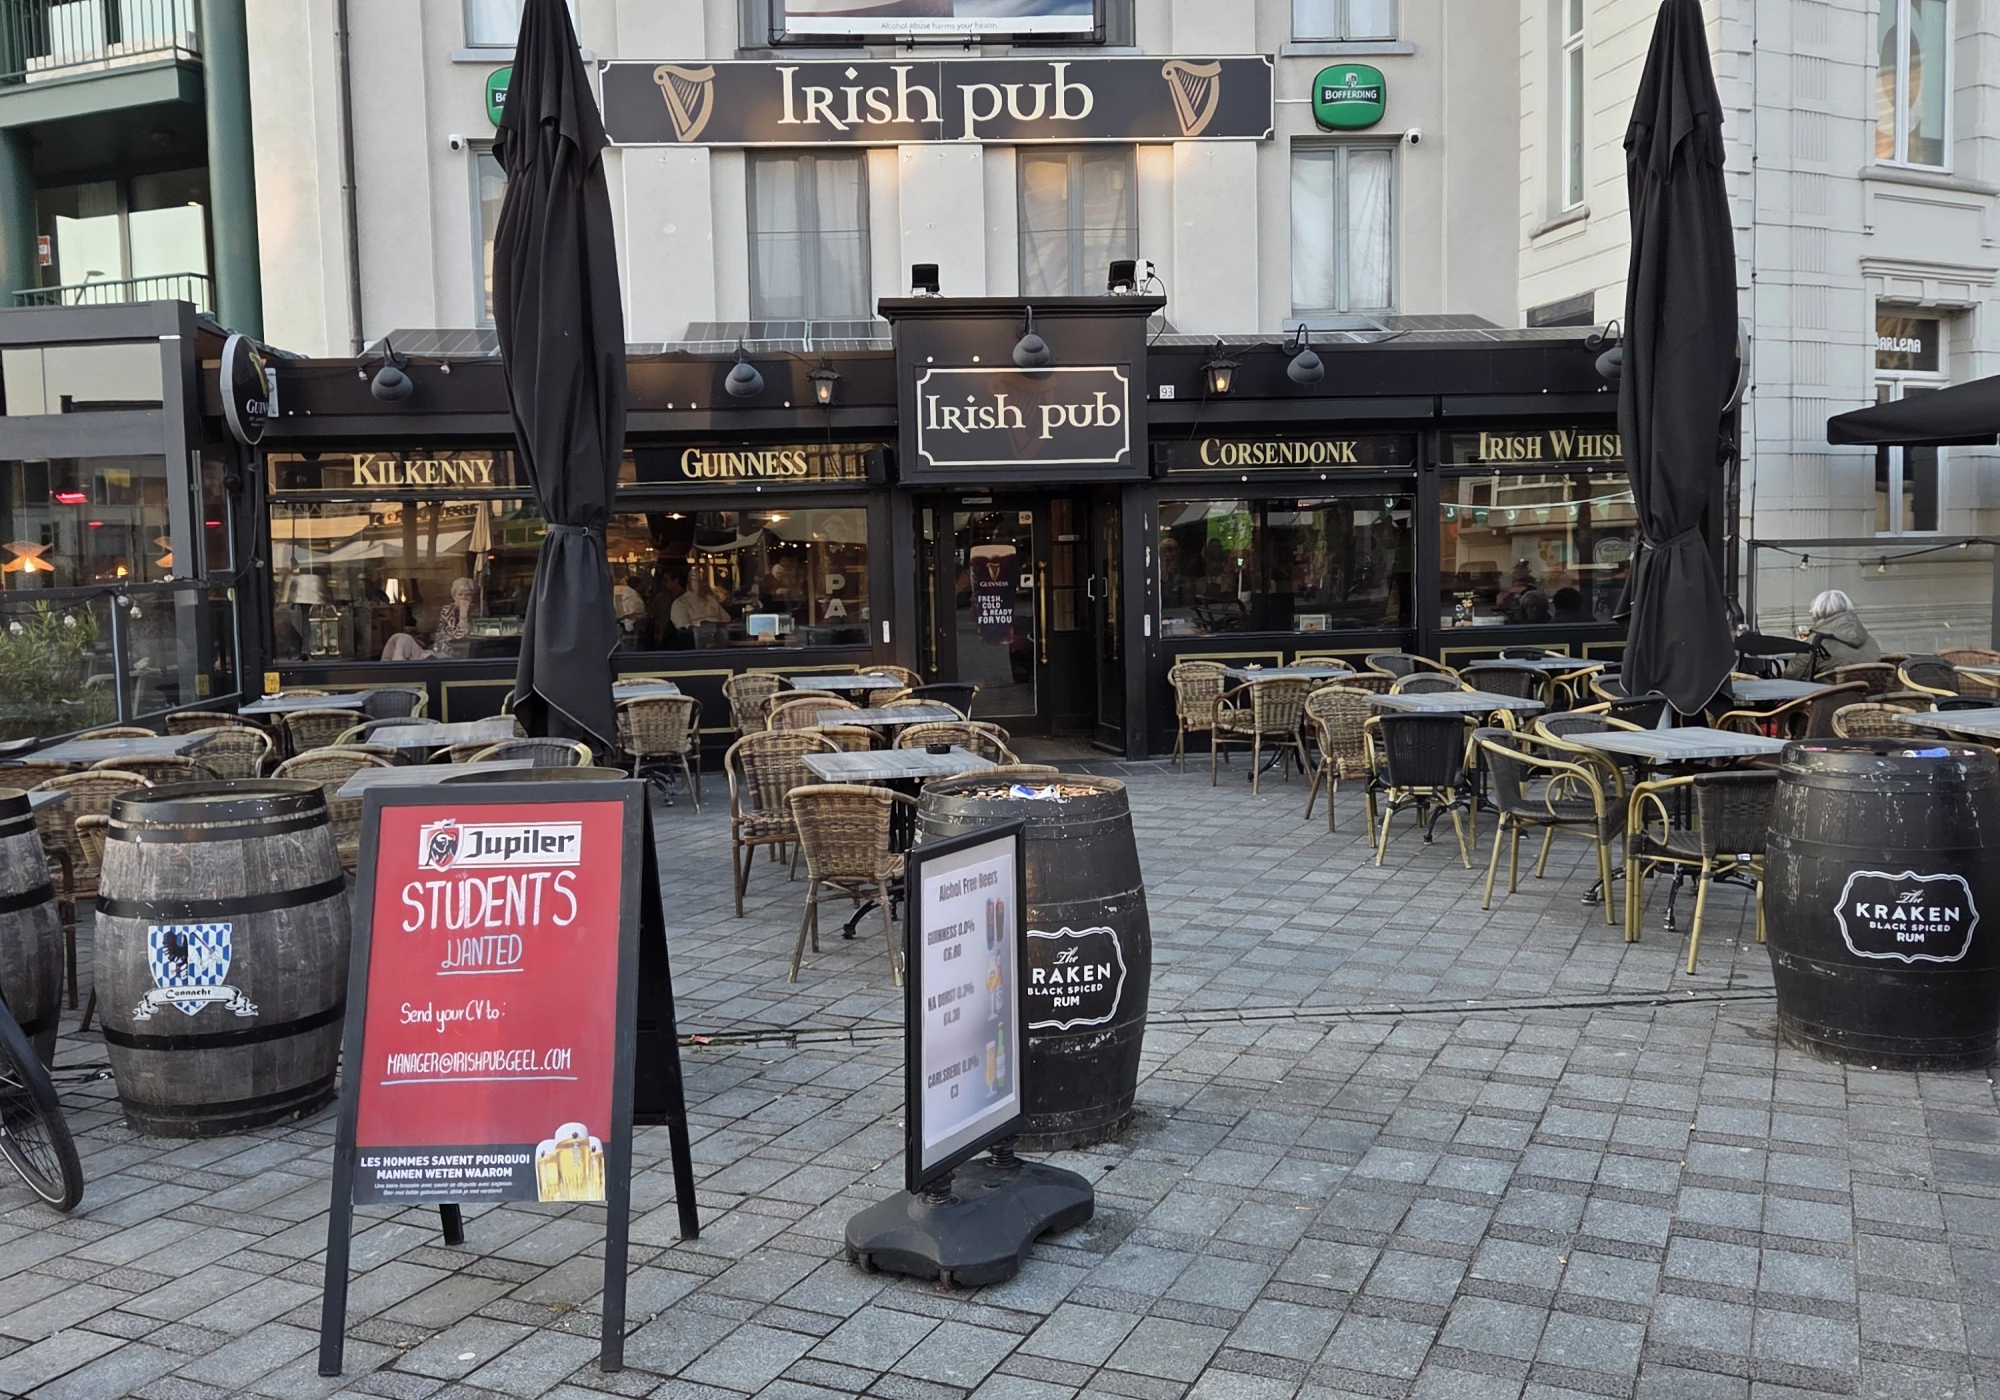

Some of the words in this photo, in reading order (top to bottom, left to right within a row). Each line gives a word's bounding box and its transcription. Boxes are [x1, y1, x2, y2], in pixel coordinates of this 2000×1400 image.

[775, 65, 944, 131] Irish
[956, 62, 1094, 140] pub
[1325, 90, 1377, 100] BOFFERDING
[1161, 387, 1173, 397] 93
[925, 393, 1026, 434] Irish
[1038, 392, 1121, 439] pub
[1200, 438, 1358, 466] CORSENDONK
[1478, 431, 1543, 460] IRISH
[351, 454, 494, 485] KILKENNY
[680, 448, 808, 478] GUINNESS
[979, 580, 1009, 588] GUINNESS
[978, 616, 994, 624] FOR
[996, 616, 1012, 624] YOU
[464, 830, 575, 860] Jupiler
[962, 876, 977, 895] Free
[402, 870, 578, 932] STUDENTS
[1896, 889, 1924, 904] The
[1856, 902, 1960, 922] KRAKEN
[928, 924, 957, 946] GUINNESS
[1869, 921, 1906, 931] BLACK
[1911, 924, 1951, 932] SPICED
[1896, 932, 1924, 942] RUM
[441, 934, 523, 968] WANTED
[1053, 946, 1078, 964] The
[1032, 962, 1110, 984] RAKEN
[166, 988, 211, 999] Connacht
[1027, 987, 1063, 996] BLACK
[1068, 984, 1103, 994] SPICED
[1054, 996, 1080, 1008] RUM
[400, 1002, 432, 1024] Send
[436, 1008, 464, 1033] your
[465, 1000, 484, 1021] CV
[387, 1048, 572, 1075] MANAGER@IRISHPUBGEEL.COM
[928, 1062, 961, 1089] CARLSBERG
[360, 1157, 380, 1167] LES
[382, 1156, 430, 1166] HOMMES
[432, 1155, 474, 1166] SAVENT
[476, 1154, 530, 1165] POURQUOI
[376, 1169, 422, 1180] MANNEN
[425, 1168, 462, 1178] WETEN
[464, 1167, 512, 1178] WAAROM
